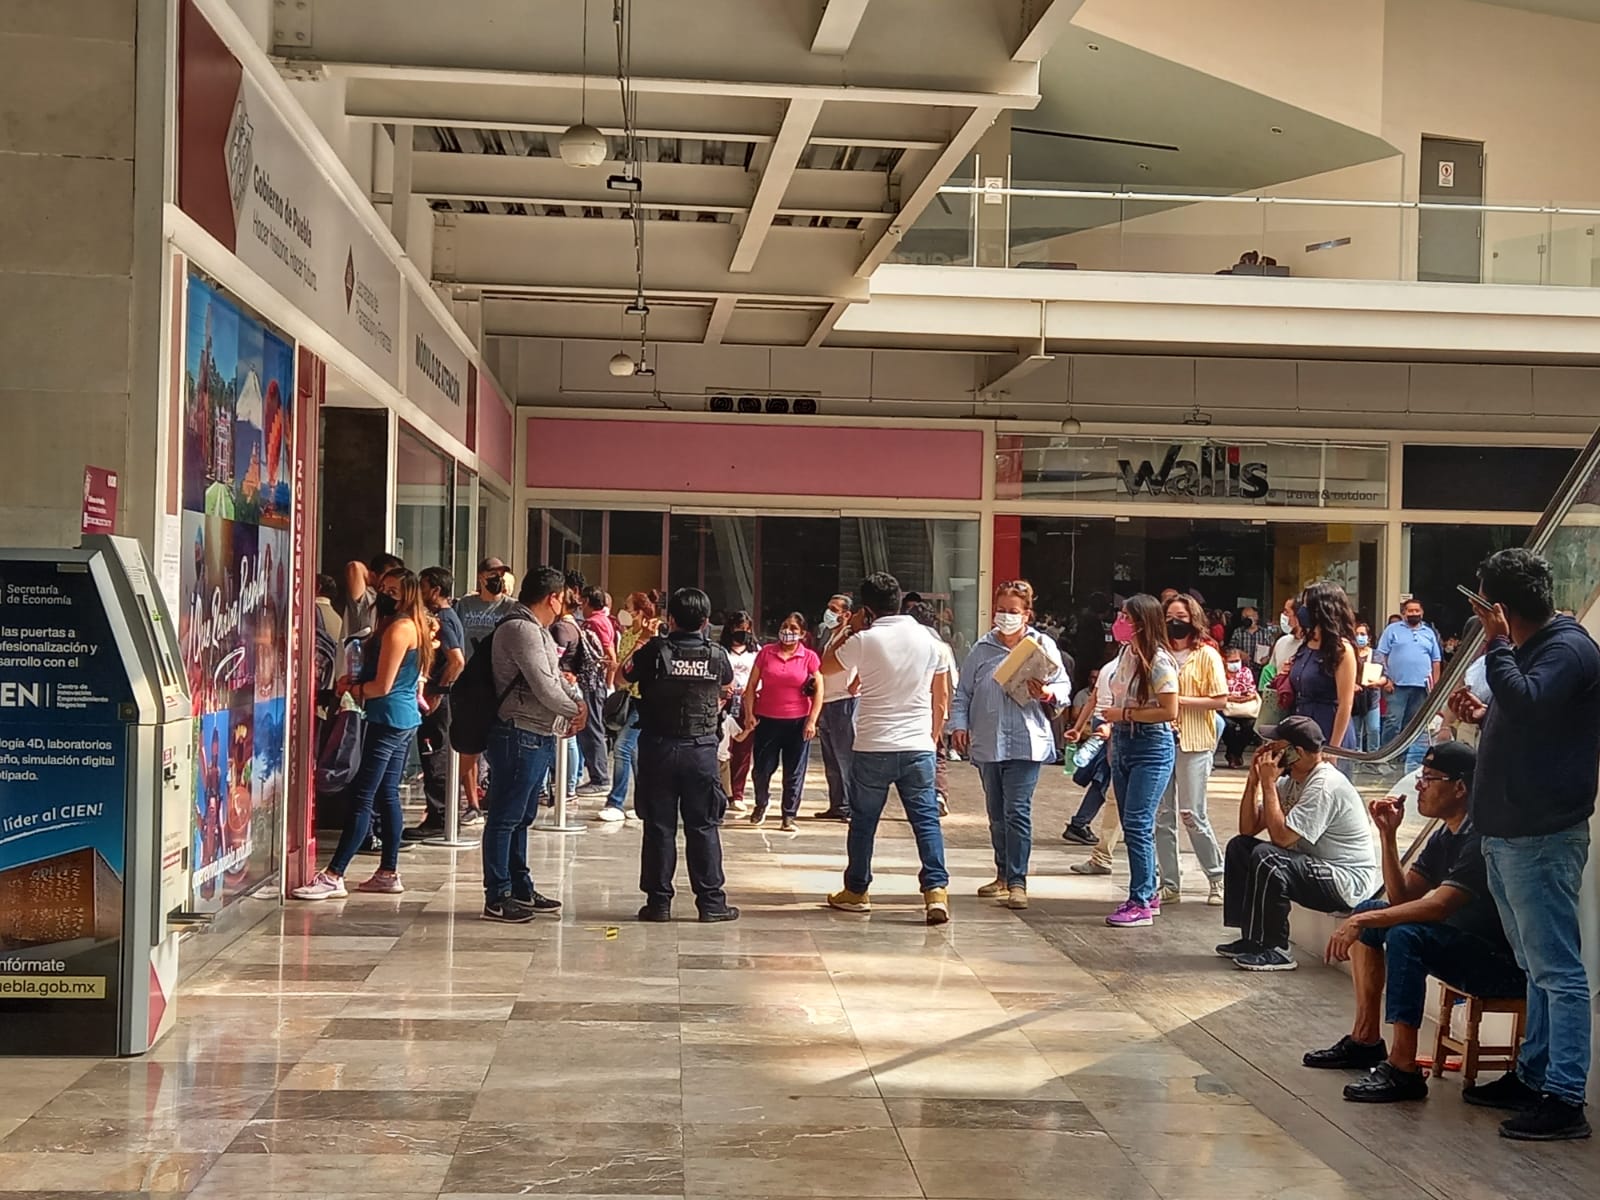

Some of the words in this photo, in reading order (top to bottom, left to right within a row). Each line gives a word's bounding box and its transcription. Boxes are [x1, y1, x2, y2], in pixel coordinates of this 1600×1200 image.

[254, 165, 283, 219] Gobierno
[285, 198, 292, 228] de
[293, 208, 311, 248] Puebla
[1321, 489, 1330, 500] &
[1333, 490, 1379, 501] outdoor
[7, 584, 59, 595] Secretaría
[7, 594, 20, 604] de
[22, 594, 72, 605] Economía
[1, 626, 19, 637] las
[20, 627, 66, 639] puertas
[68, 629, 76, 638] a
[0, 640, 88, 653] fesionalización
[90, 644, 98, 656] y
[43, 658, 66, 668] con
[68, 657, 79, 668] el
[26, 738, 46, 750] 4D,
[47, 738, 112, 750] laboratorios
[22, 754, 80, 766] simulación
[82, 755, 115, 768] digital
[0, 770, 39, 782] tipado.
[3, 814, 39, 832] líder
[42, 807, 57, 822] al
[60, 802, 104, 819] CIEN!
[0, 956, 66, 972] nfórmate
